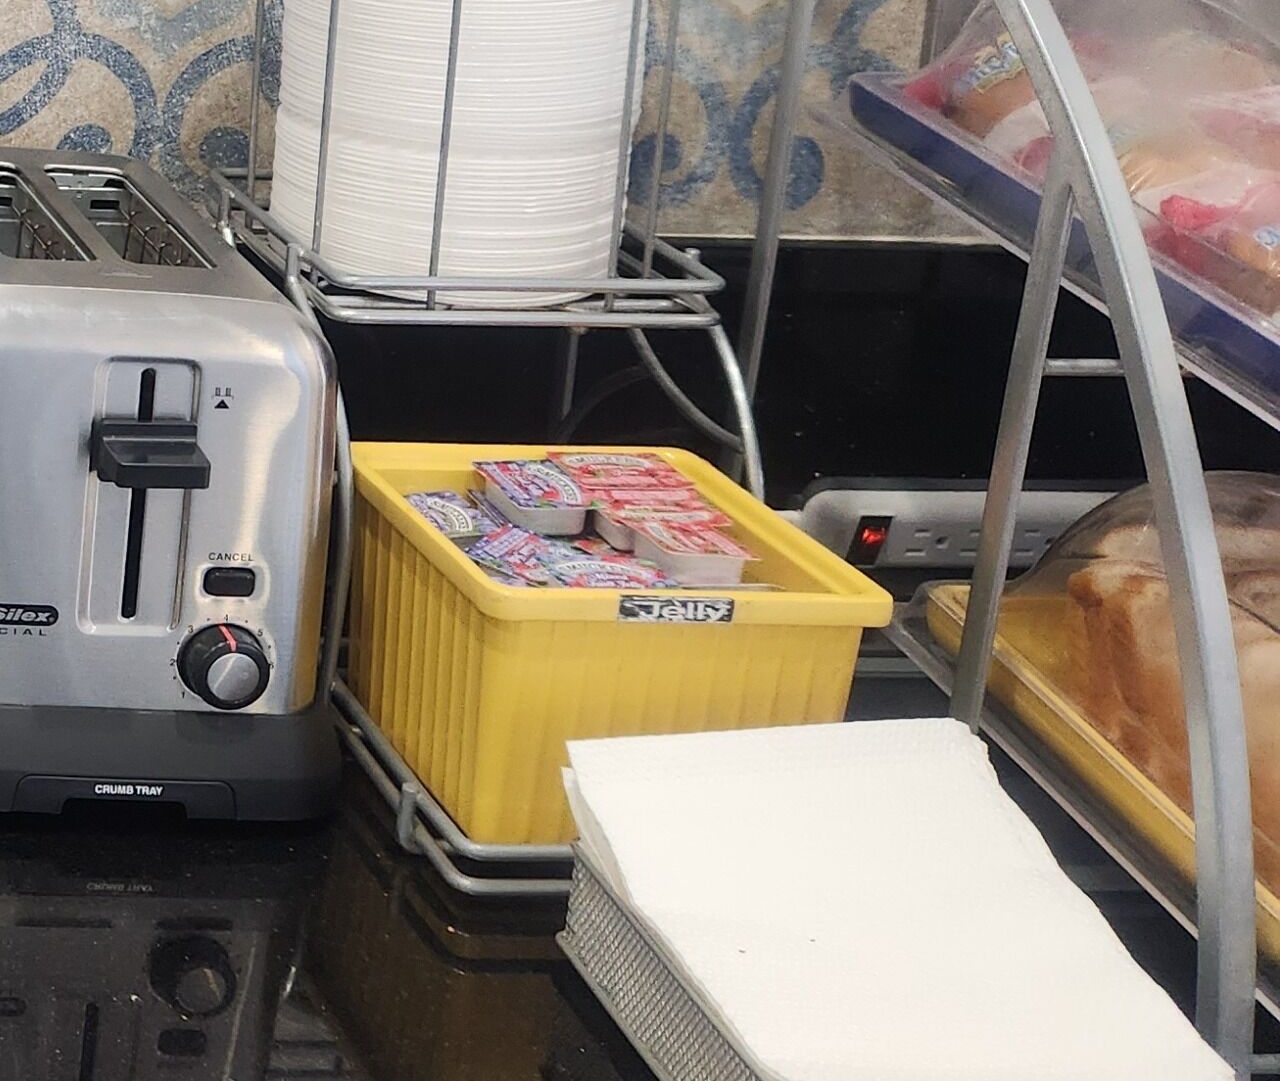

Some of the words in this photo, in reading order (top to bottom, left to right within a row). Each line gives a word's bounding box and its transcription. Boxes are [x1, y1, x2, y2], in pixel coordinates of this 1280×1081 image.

[208, 552, 255, 563] CANCEL
[639, 598, 730, 623] Jelly
[257, 629, 264, 637] 5
[169, 658, 177, 667] 2
[94, 784, 134, 796] CRUMB
[134, 785, 164, 797] TRAY
